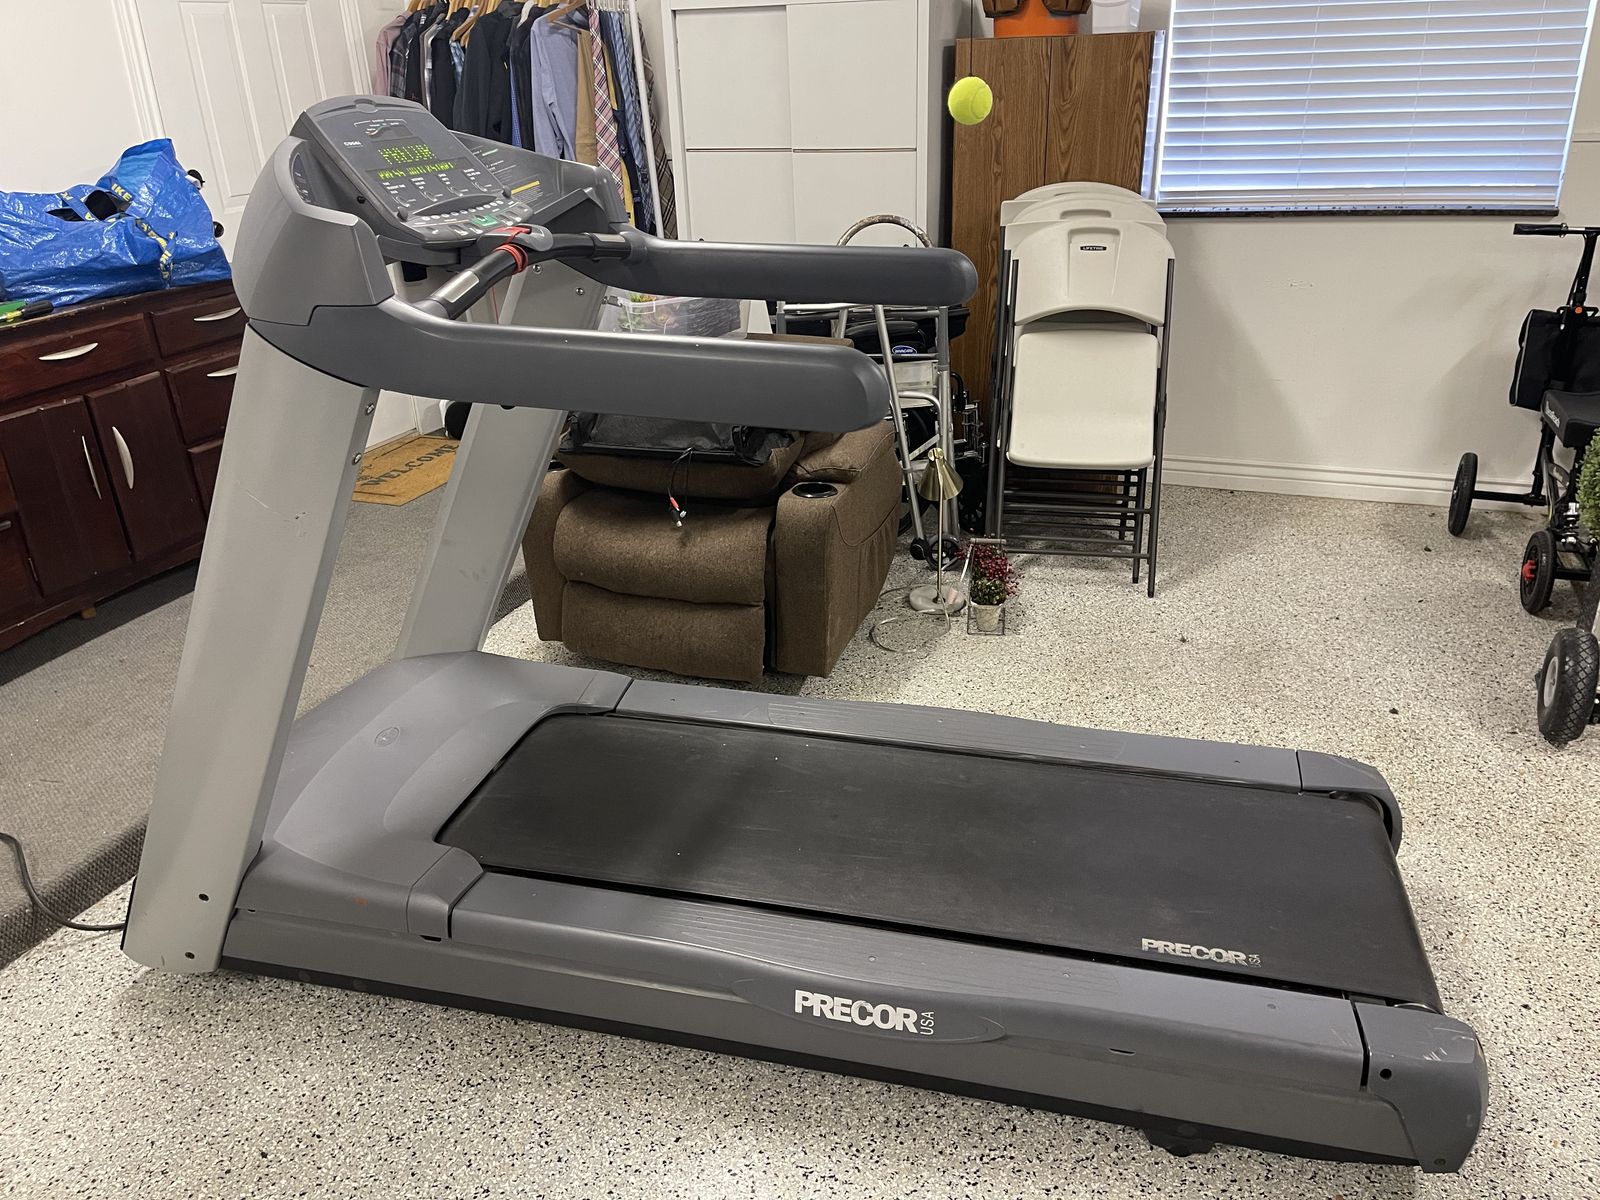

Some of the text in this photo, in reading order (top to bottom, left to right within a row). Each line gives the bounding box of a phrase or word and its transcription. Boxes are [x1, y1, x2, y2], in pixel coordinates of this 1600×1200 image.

[111, 183, 133, 202] IKE
[360, 444, 460, 487] WELCOME
[1141, 938, 1248, 967] PRECOR
[794, 989, 935, 1036] PRECOR USA
